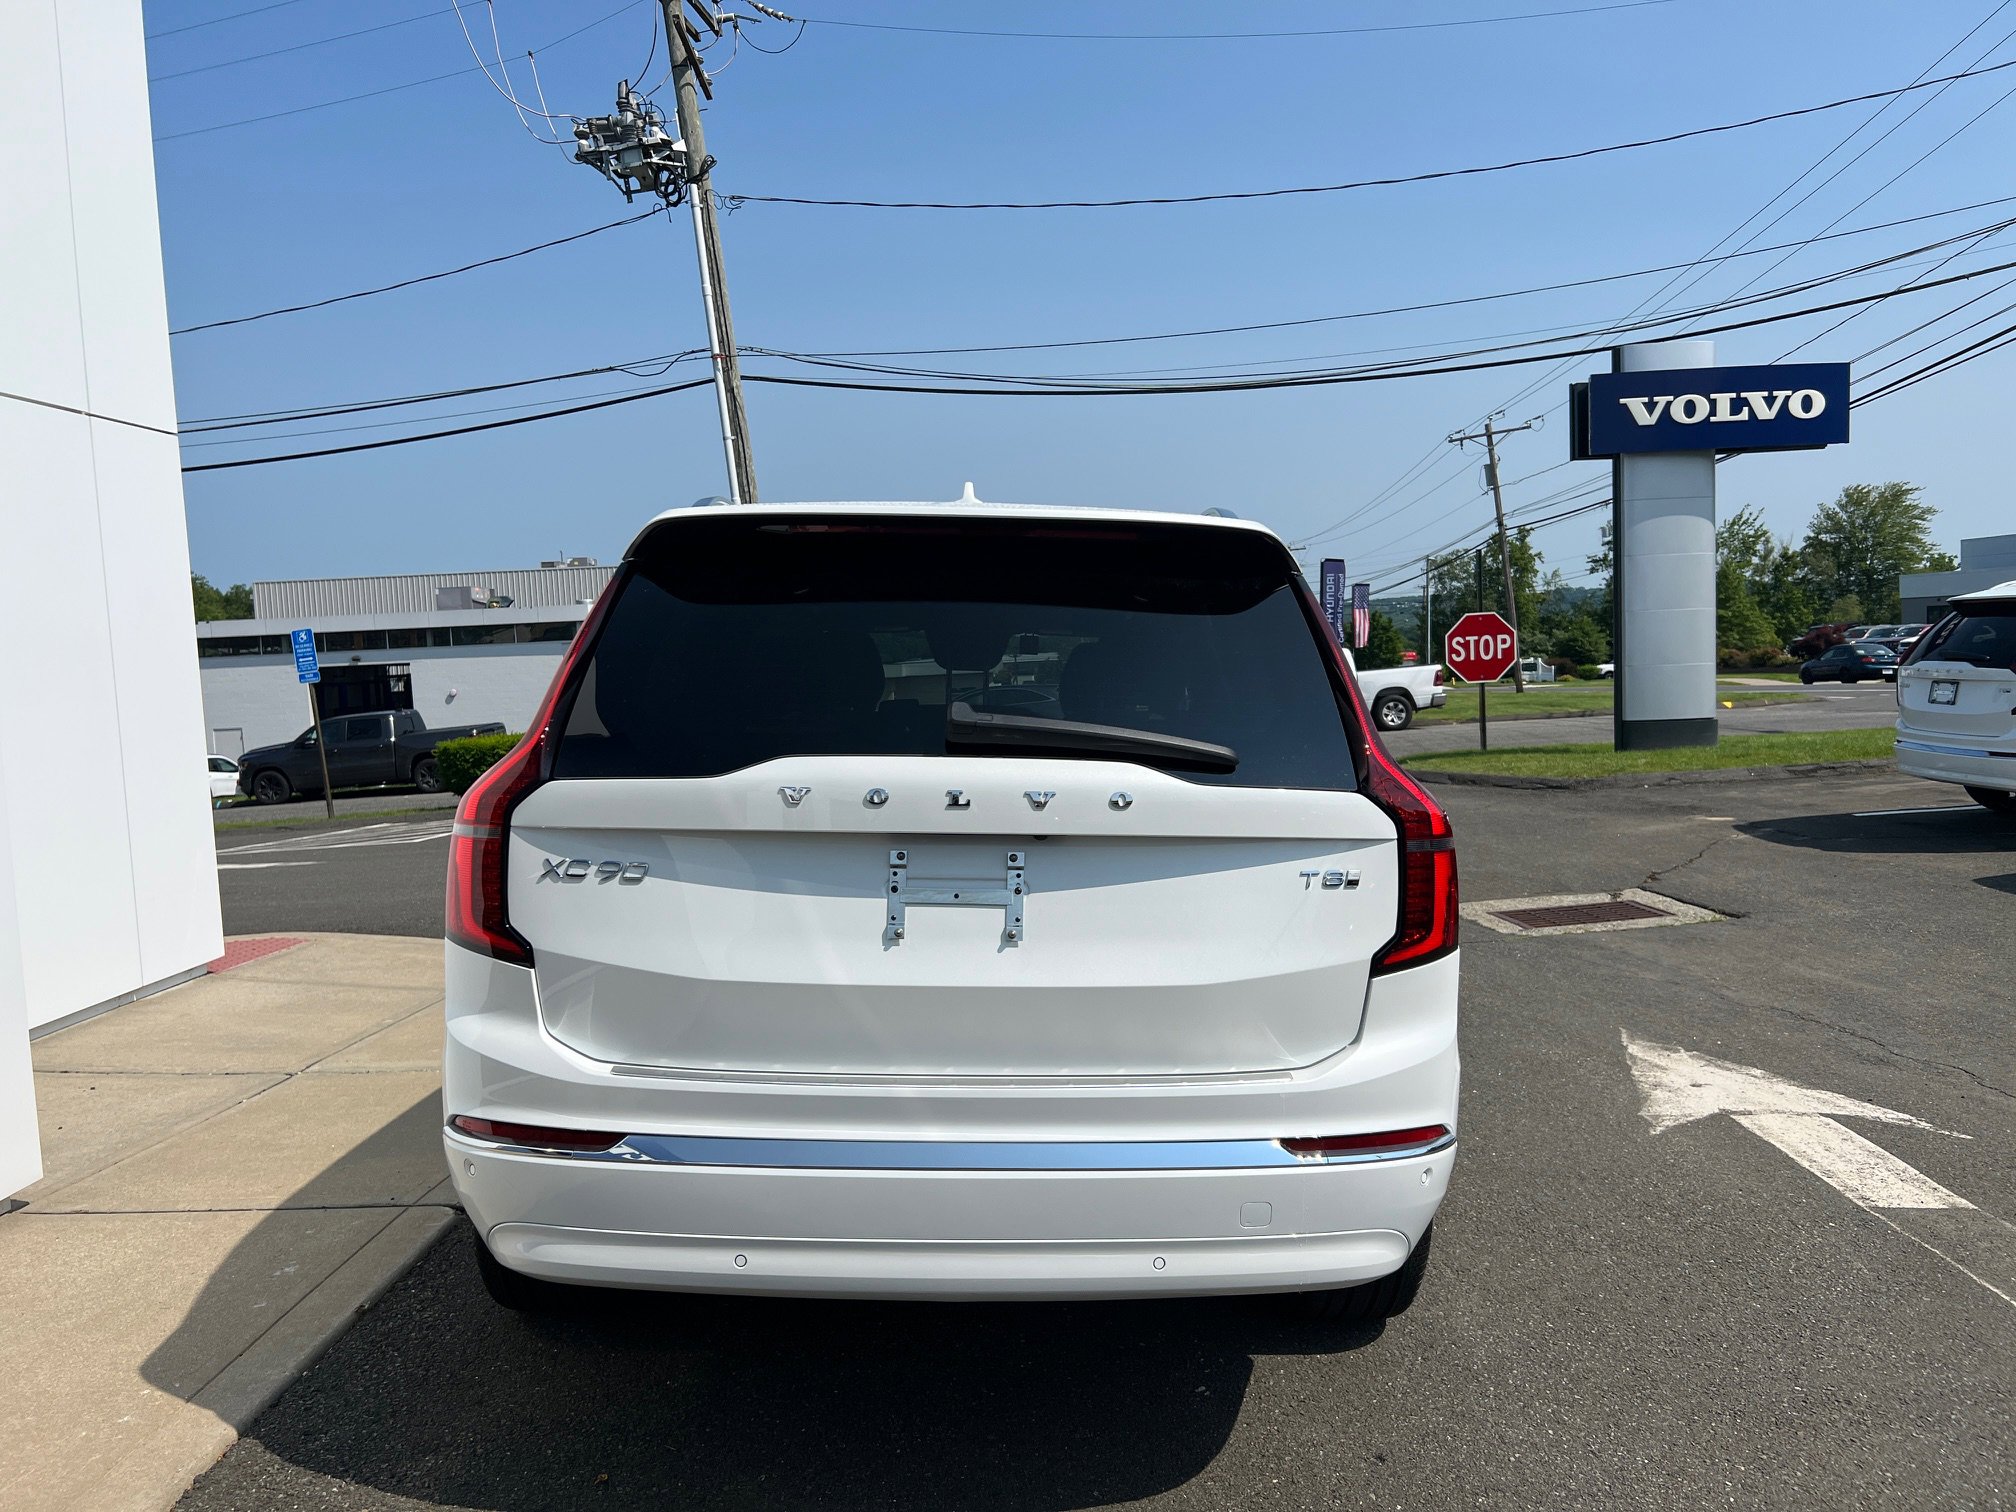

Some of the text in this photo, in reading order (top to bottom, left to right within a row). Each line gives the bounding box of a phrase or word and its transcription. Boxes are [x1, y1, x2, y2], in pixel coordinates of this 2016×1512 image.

[1619, 389, 1826, 426] VOLVO
[1326, 573, 1335, 623] HYUNDAI
[1451, 634, 1511, 662] STOP
[778, 786, 1134, 812] VOLVO
[539, 857, 649, 882] XC90
